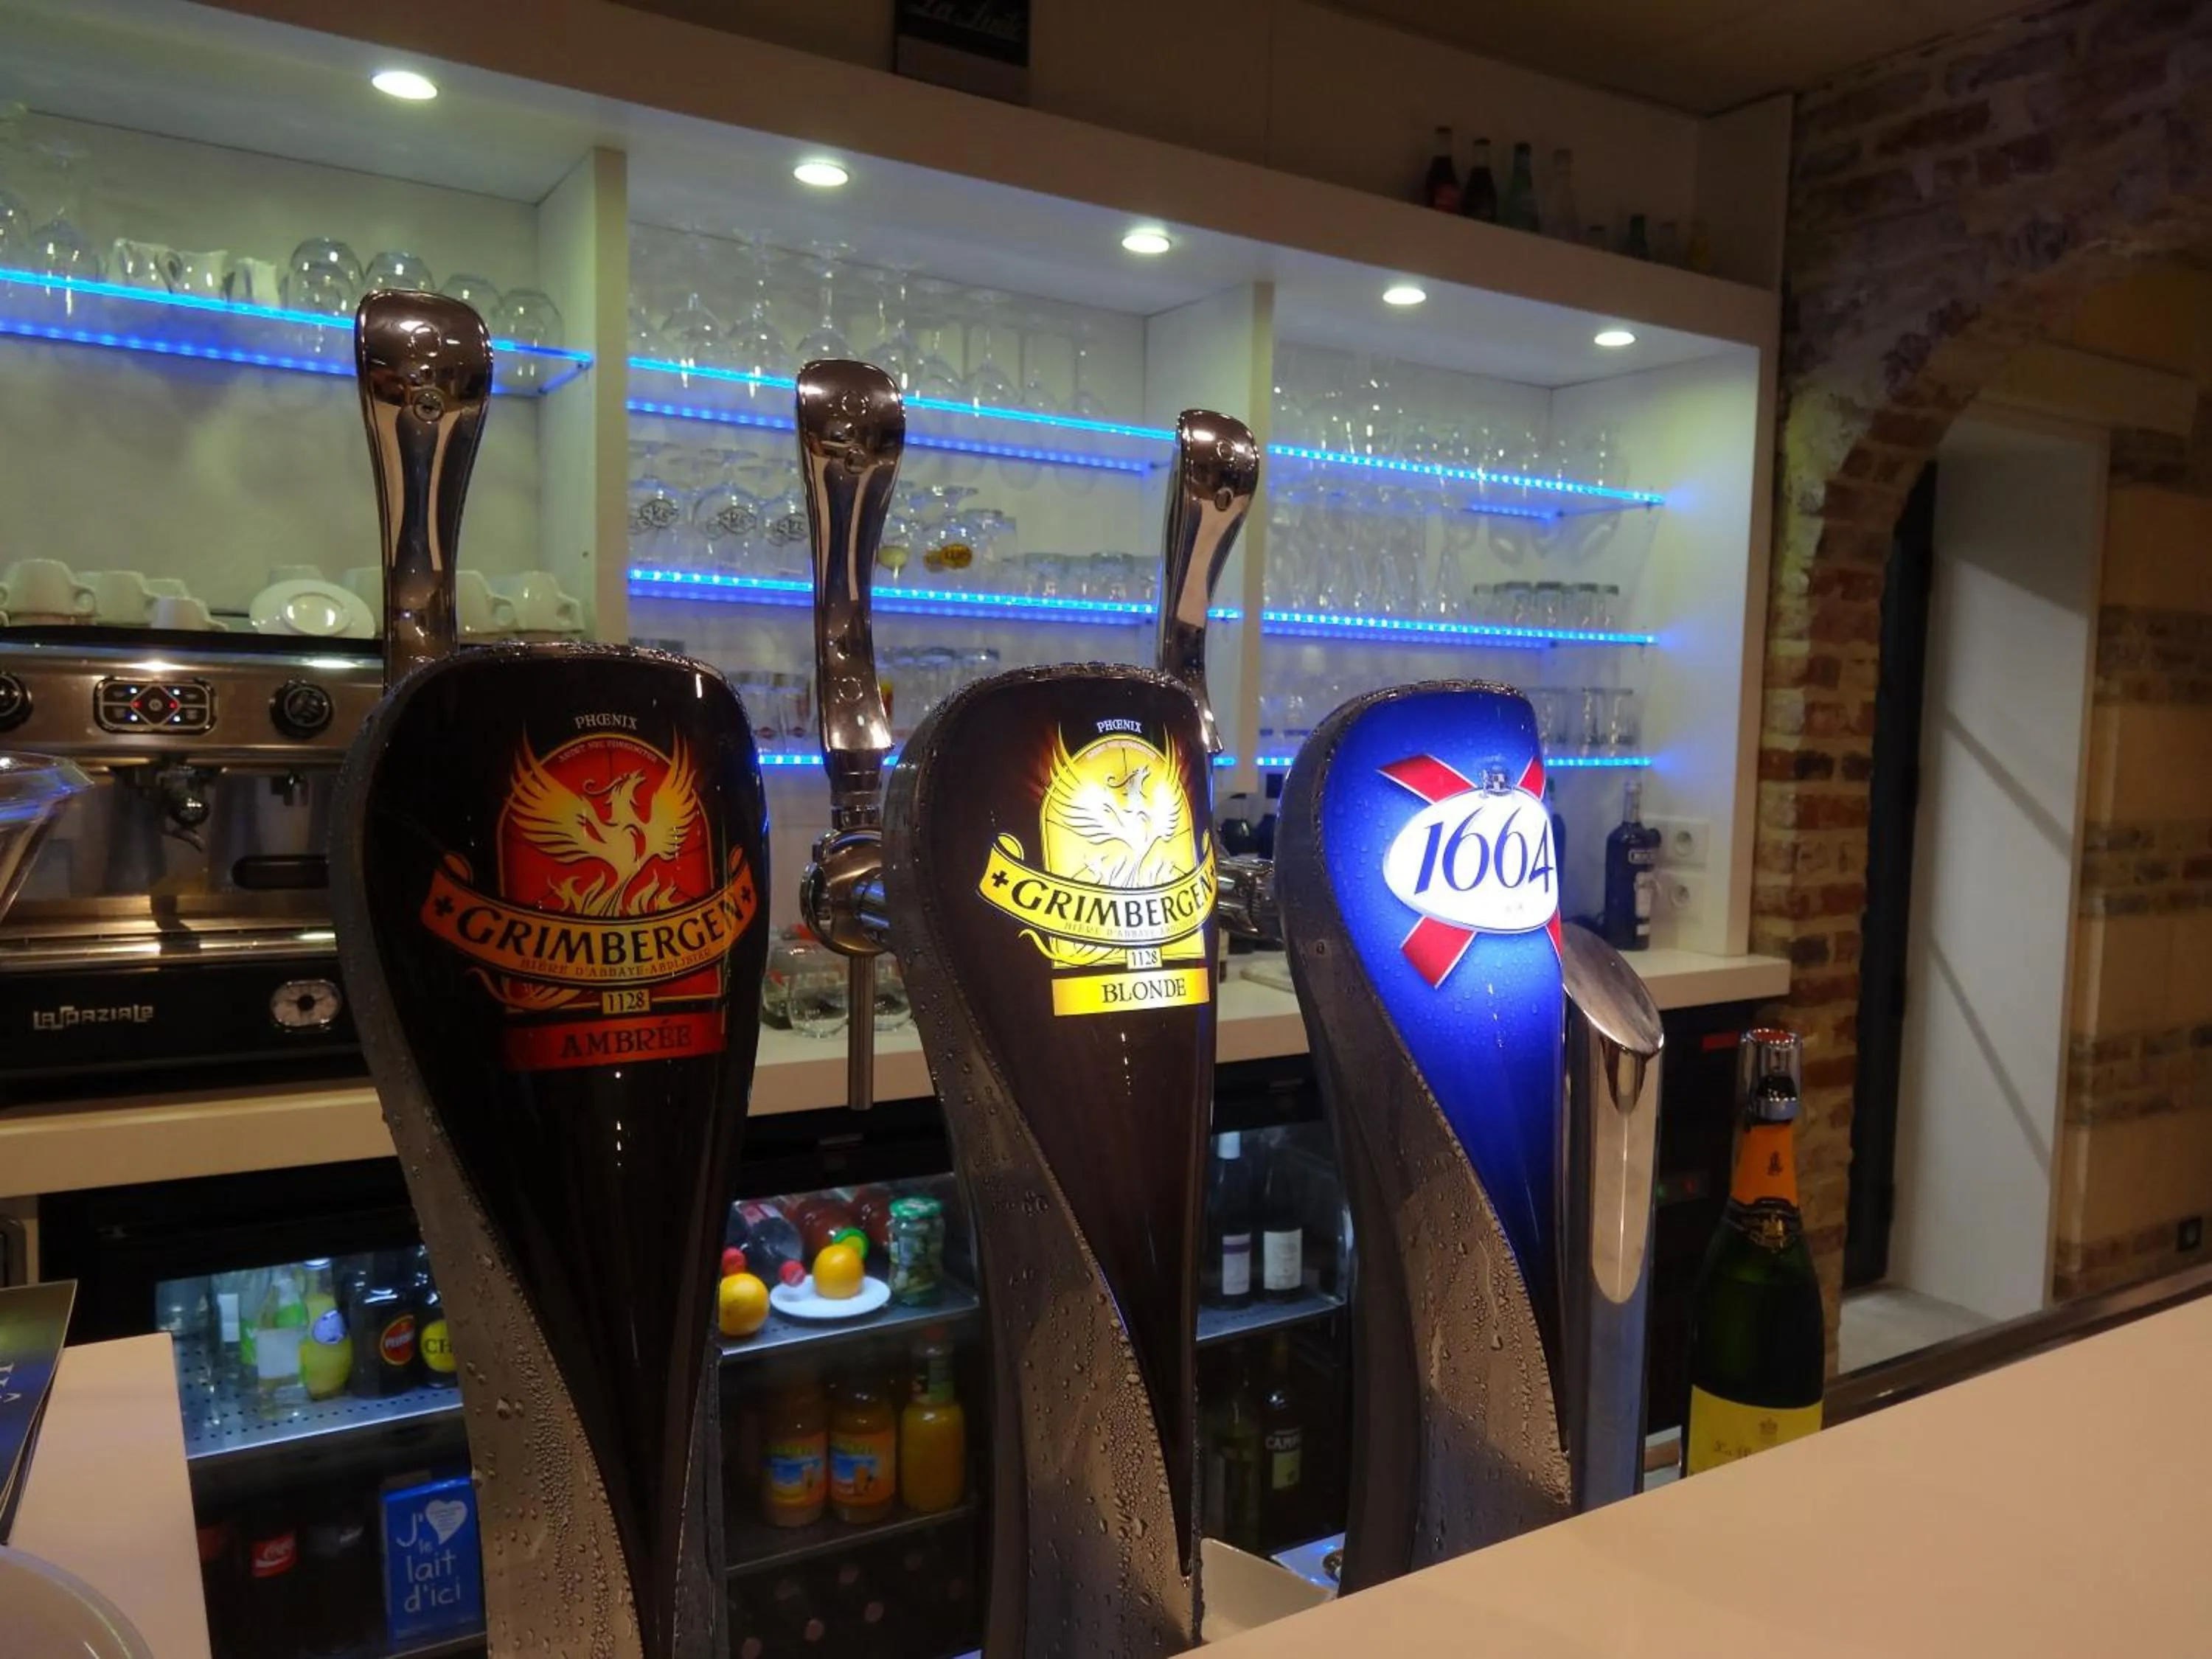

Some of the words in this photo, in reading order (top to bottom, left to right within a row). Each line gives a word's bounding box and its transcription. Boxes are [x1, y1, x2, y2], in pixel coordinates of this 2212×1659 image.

[1414, 807, 1554, 895] 1664
[1011, 874, 1214, 928] GRIMBERGEN
[457, 892, 745, 966] GRIMBERGEN
[1132, 950, 1158, 967] 1128
[608, 991, 645, 1012] 1128
[1101, 977, 1186, 1004] BLONDE
[559, 1019, 692, 1058] AMBRÉE
[406, 1548, 457, 1583] lait
[404, 1575, 461, 1613] d'ici
